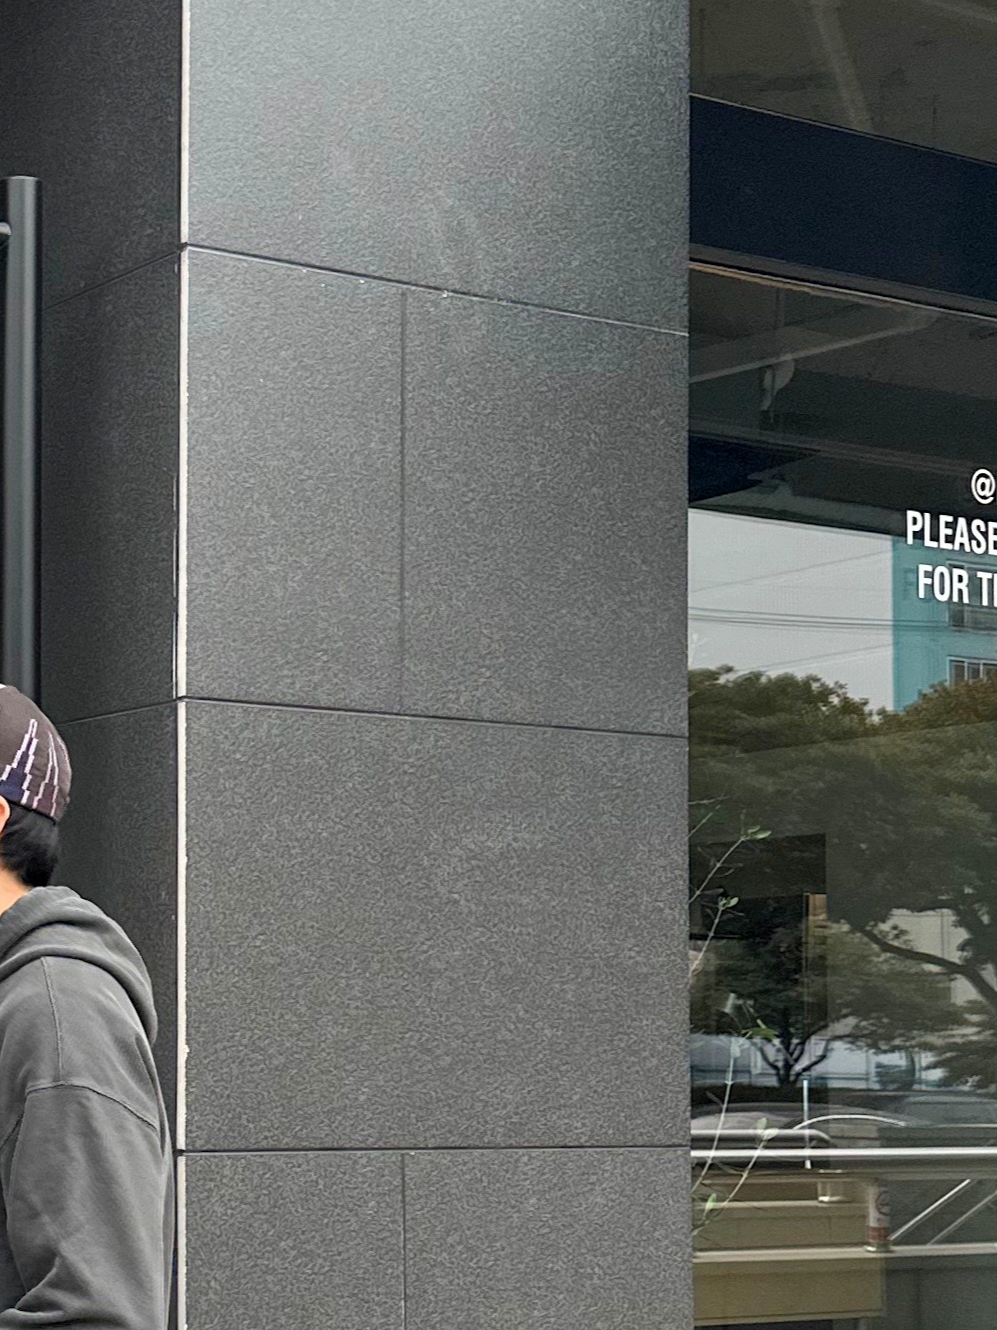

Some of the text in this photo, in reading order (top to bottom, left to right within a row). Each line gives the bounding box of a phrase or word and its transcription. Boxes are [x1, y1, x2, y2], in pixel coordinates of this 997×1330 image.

[906, 509, 997, 556] PLEASE
[918, 563, 997, 608] FOR T
